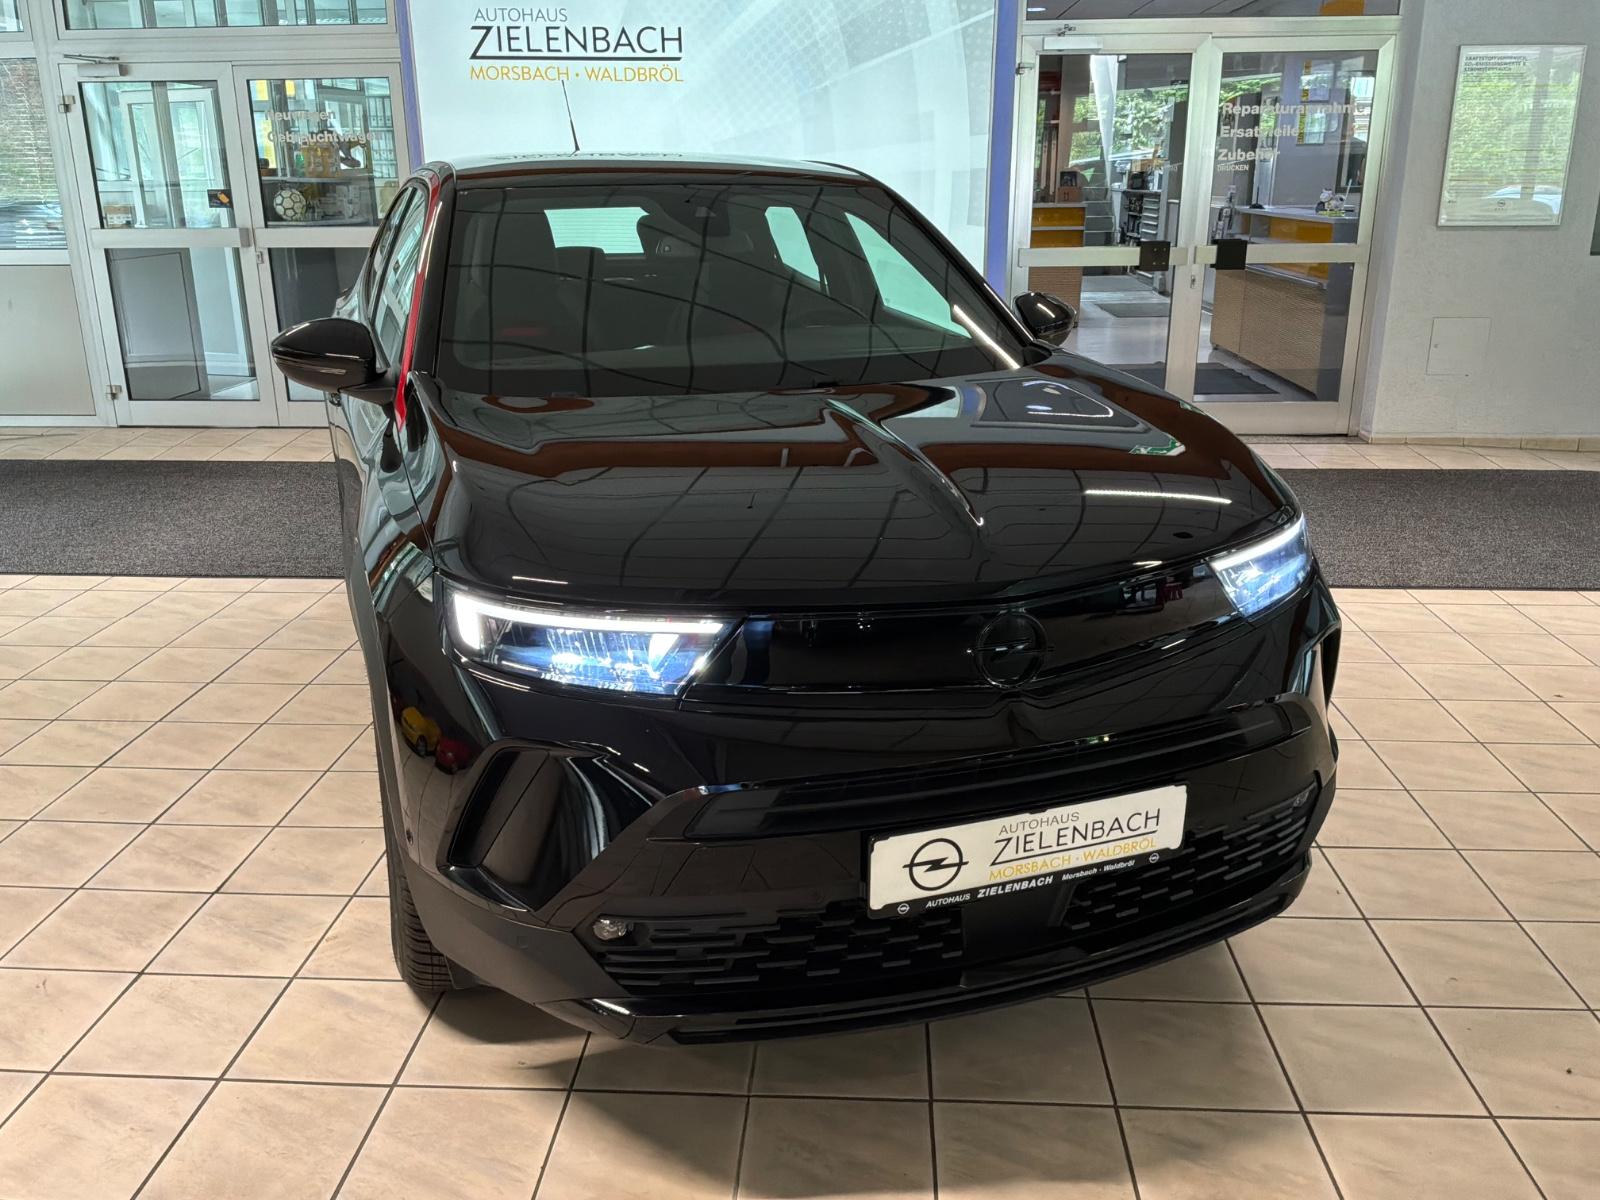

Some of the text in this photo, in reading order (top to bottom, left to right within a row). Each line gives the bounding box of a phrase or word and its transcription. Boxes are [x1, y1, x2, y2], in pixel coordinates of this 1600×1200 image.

[473, 8, 568, 22] AUTOHAUS
[469, 26, 683, 60] ZIELENBACH
[469, 64, 684, 82] MORSBACH WALDBRÖL
[267, 130, 383, 145] Gebrauchtwage
[989, 808, 1161, 867] ZIELENBACH
[998, 811, 1080, 837] AUTOHAUS
[988, 854, 1072, 882] MORSBACH
[925, 893, 971, 908] AUTOHAUS
[977, 875, 1054, 898] ZIELENBACH
[1062, 867, 1098, 880] Morsbach
